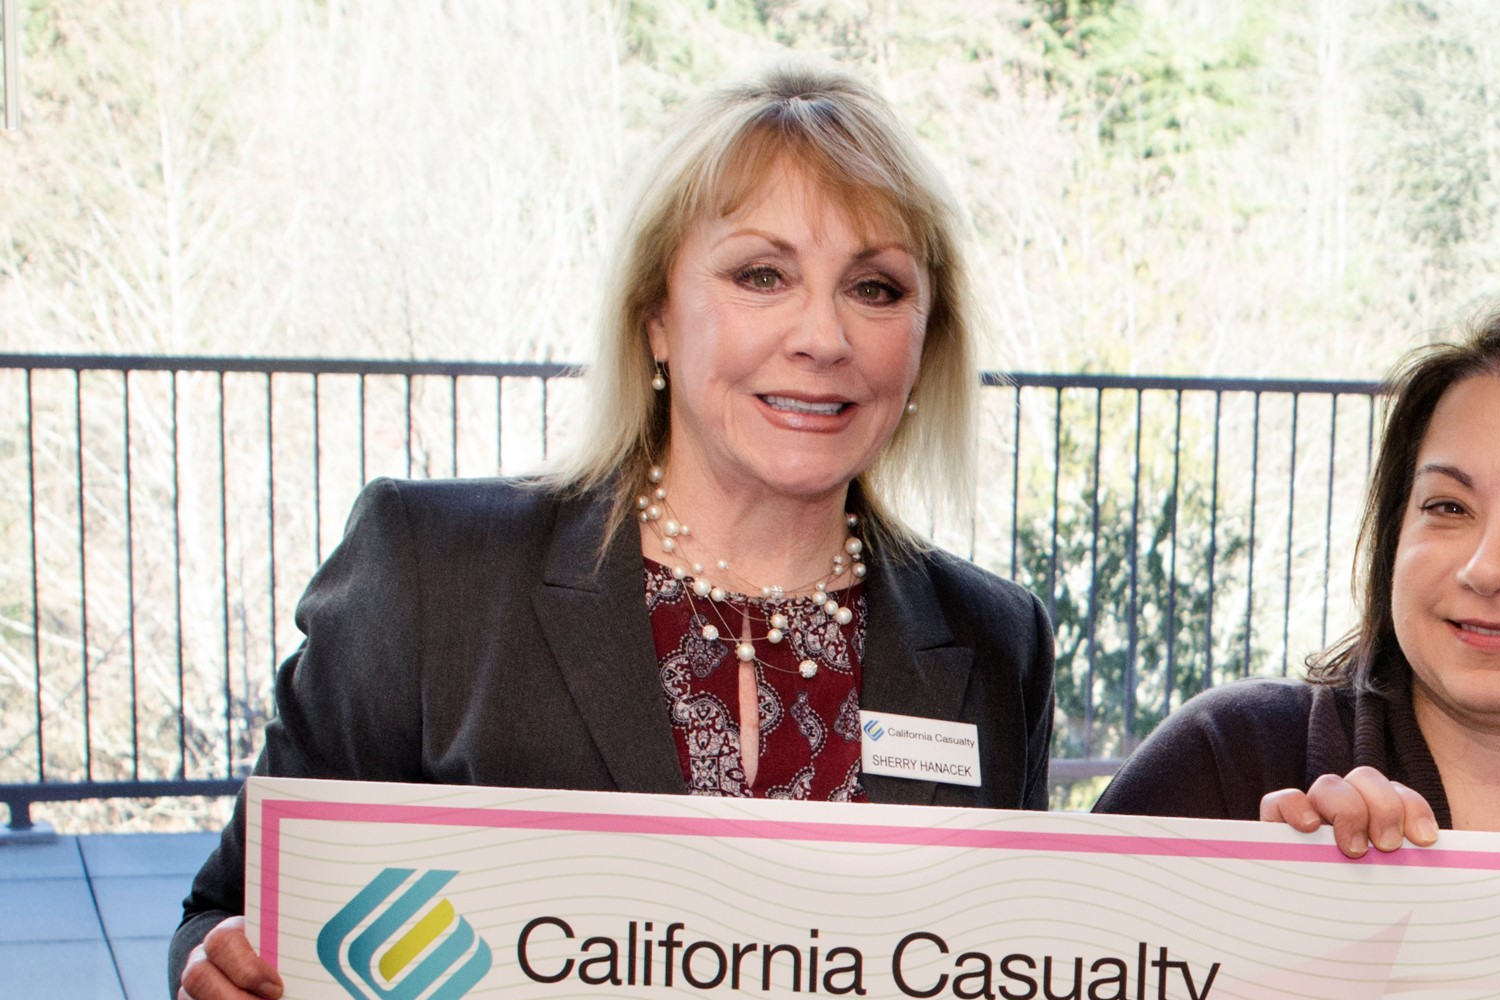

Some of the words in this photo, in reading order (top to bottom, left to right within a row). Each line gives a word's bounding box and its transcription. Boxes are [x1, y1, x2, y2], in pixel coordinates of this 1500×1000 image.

[888, 728, 933, 742] California
[935, 733, 975, 748] Casualty
[872, 754, 918, 770] SHERRY
[920, 760, 972, 777] HANACEK
[516, 915, 867, 997] California
